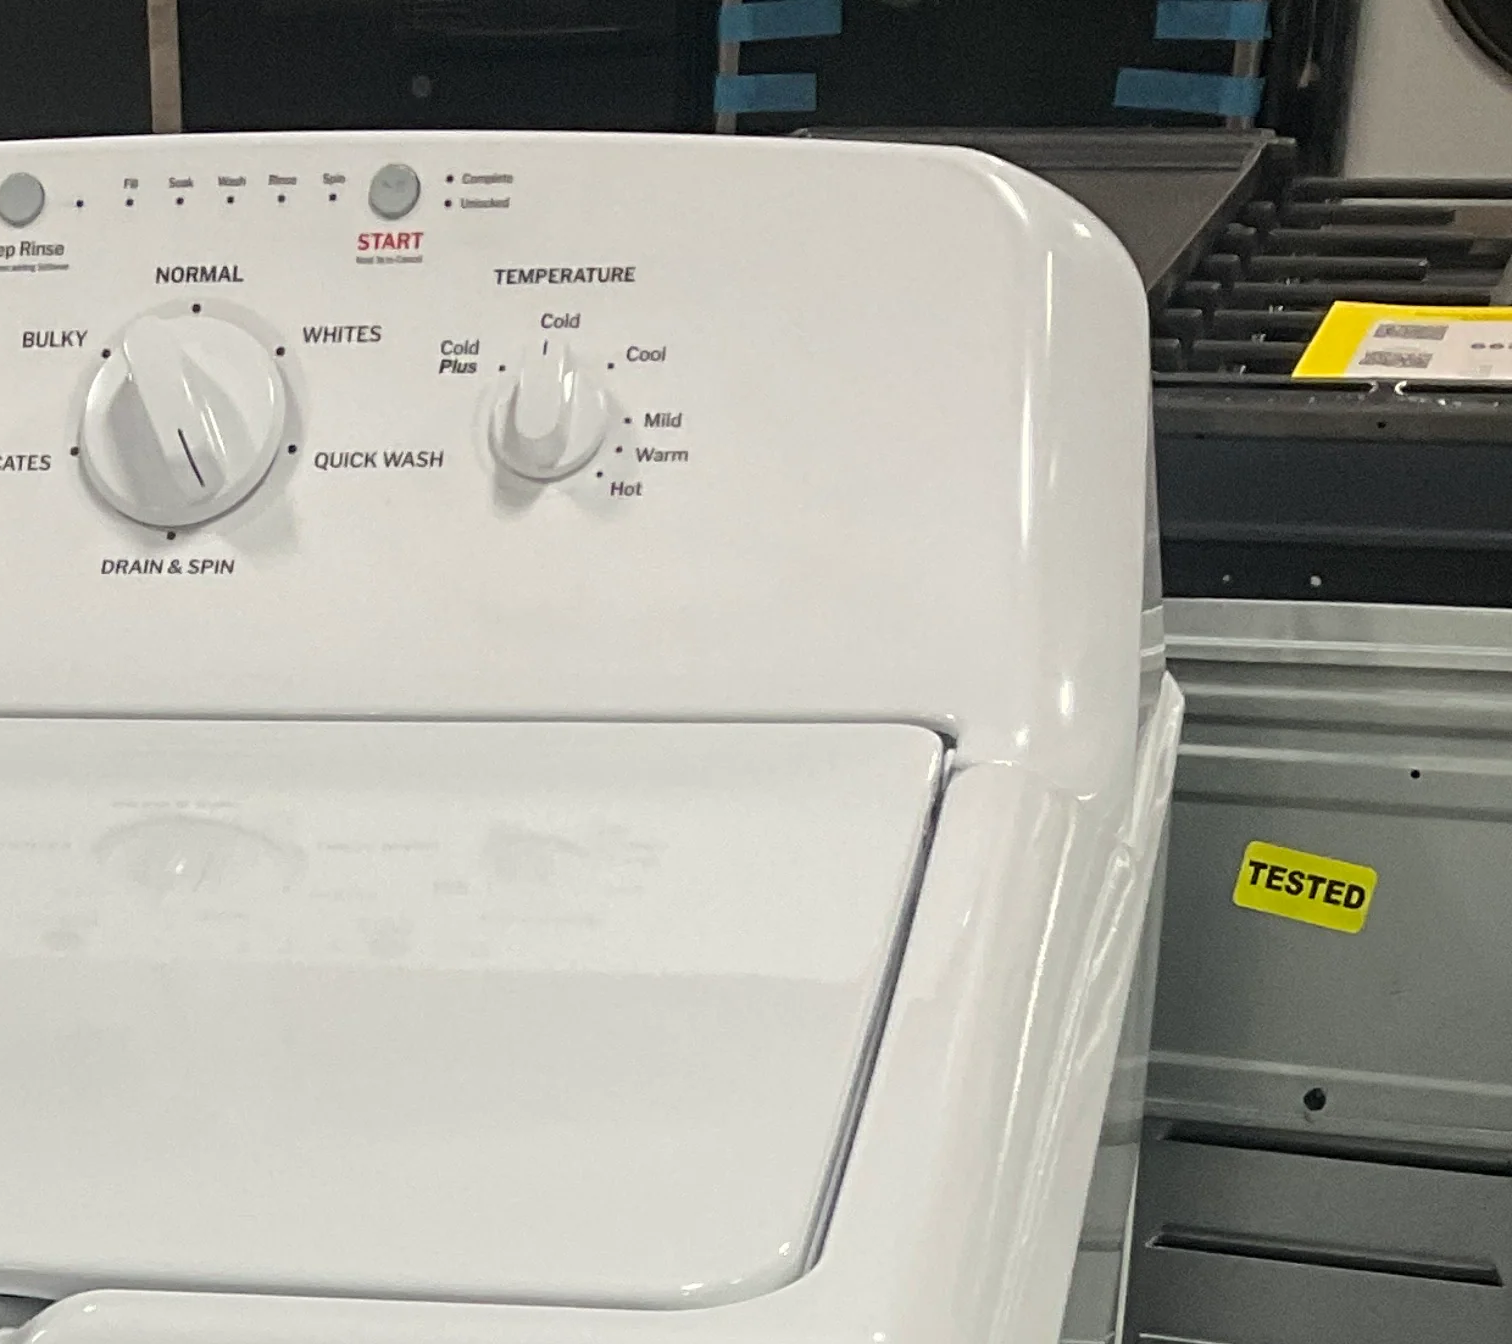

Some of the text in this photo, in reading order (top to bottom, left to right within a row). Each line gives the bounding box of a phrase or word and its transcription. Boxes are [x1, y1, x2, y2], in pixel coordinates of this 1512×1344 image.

[19, 240, 65, 257] Rinse
[357, 231, 424, 251] START
[155, 264, 245, 284] NORMAL
[493, 266, 636, 285] TEMPERATURE
[540, 312, 581, 330] Cold
[22, 329, 88, 349] BULKY
[302, 324, 382, 344] WHITES
[440, 338, 481, 356] Cold
[625, 345, 667, 363] Cool
[438, 358, 478, 375] Plus
[643, 412, 683, 429] Mild
[314, 450, 445, 471] QUICK WASH
[635, 447, 689, 463] Warm
[610, 480, 643, 497] Hot
[100, 558, 235, 575] DRAIN & SPIN
[1248, 859, 1365, 910] TESTED
